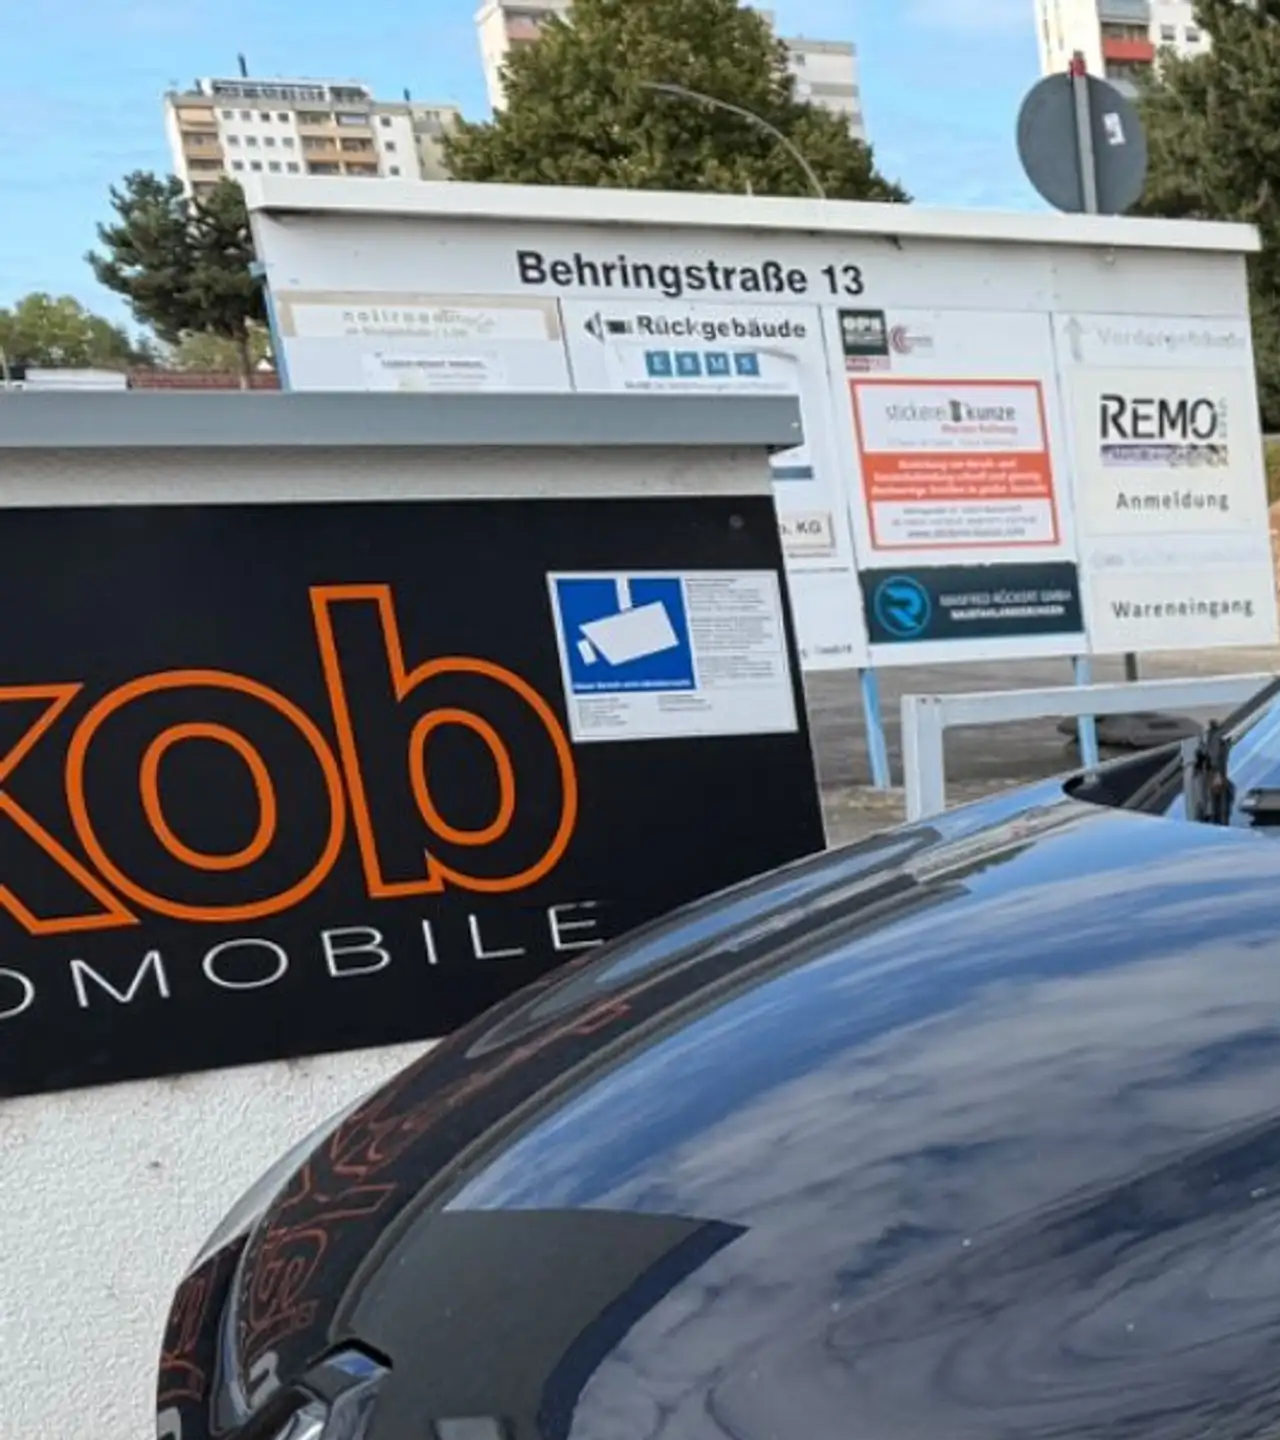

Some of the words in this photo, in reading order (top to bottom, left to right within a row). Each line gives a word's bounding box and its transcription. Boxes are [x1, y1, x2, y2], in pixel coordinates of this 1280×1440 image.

[516, 250, 808, 297] Behringstraße
[821, 264, 864, 295] 13
[637, 315, 807, 340] Rückgebäude
[1100, 394, 1218, 439] REMO
[1116, 490, 1229, 511] Anmeldung
[1111, 598, 1254, 619] Wareneingang
